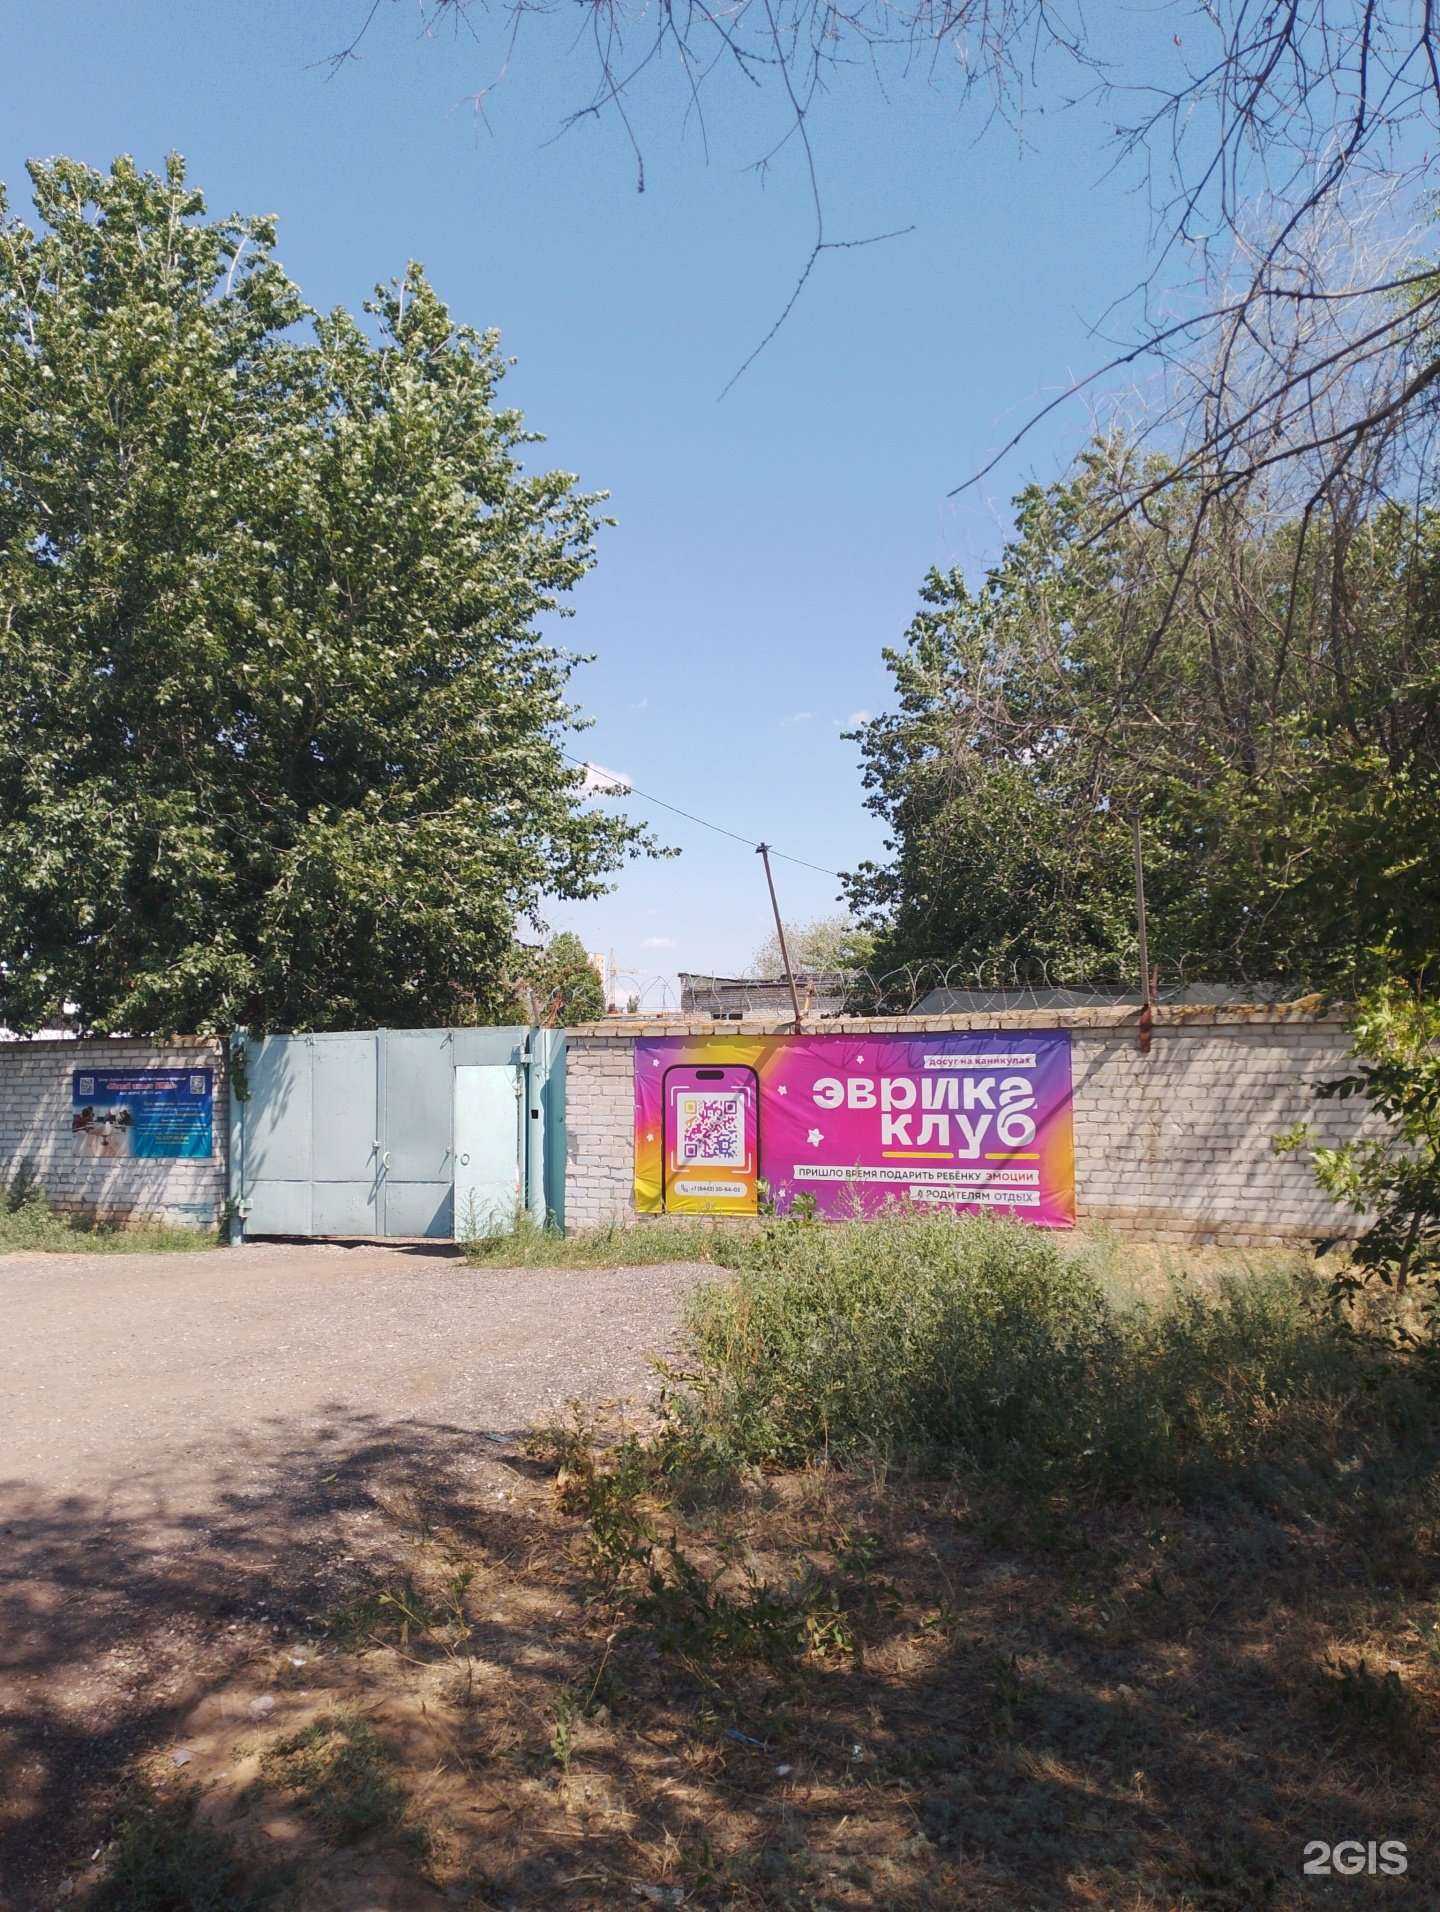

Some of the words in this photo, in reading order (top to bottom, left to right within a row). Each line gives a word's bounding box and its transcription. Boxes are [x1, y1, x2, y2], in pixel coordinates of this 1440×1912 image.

[799, 1168, 843, 1177] ПРИШЛО
[846, 1169, 877, 1178] ВРЕМЯ
[880, 1170, 934, 1180] ПОДАРИТЬ
[936, 1170, 981, 1181] РЕБЁНКУ
[986, 1173, 1033, 1182] ЭМОЦИИ
[926, 1189, 990, 1201] РОДИТЕЛЯМ
[994, 1192, 1032, 1202] ОТДЫХ
